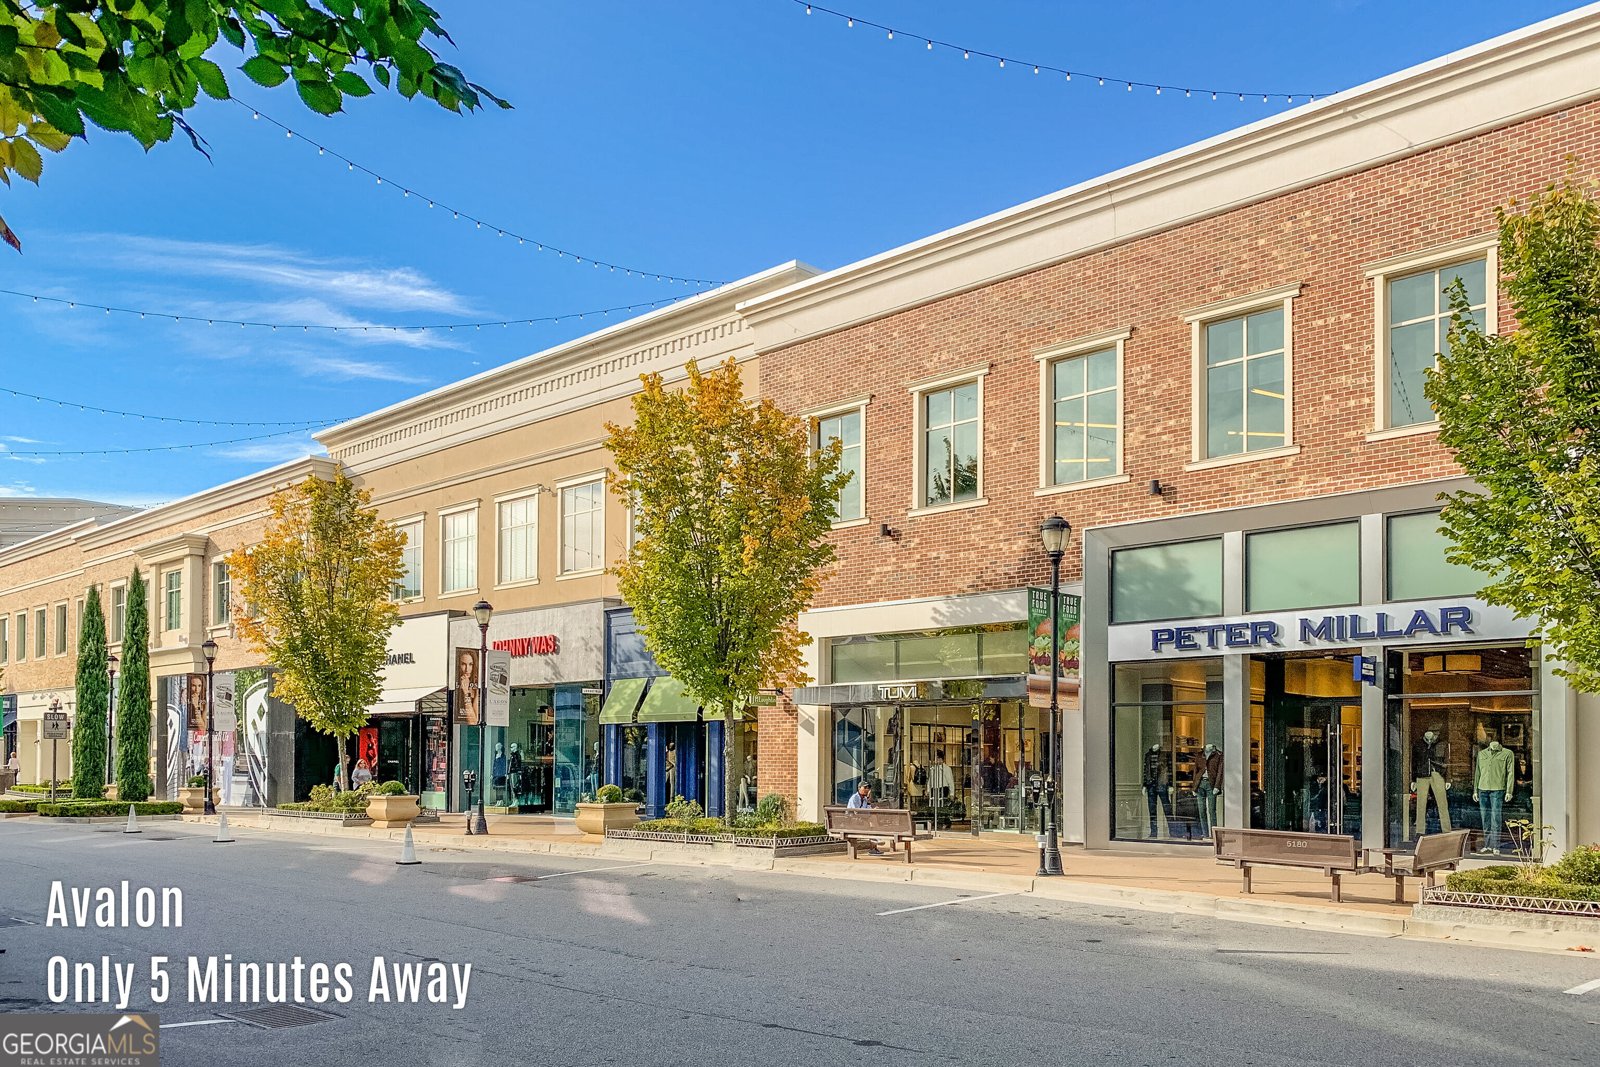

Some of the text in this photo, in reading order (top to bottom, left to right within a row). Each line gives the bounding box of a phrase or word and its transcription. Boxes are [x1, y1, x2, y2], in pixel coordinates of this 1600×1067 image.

[1032, 590, 1047, 600] TRUE
[1032, 600, 1047, 609] FOOD
[1063, 596, 1077, 606] TRUE
[1063, 605, 1077, 614] FOOD
[1151, 606, 1473, 651] PETER MILLAR
[383, 652, 416, 666] HANEL
[878, 684, 917, 699] TUMI
[1286, 840, 1308, 848] 5180
